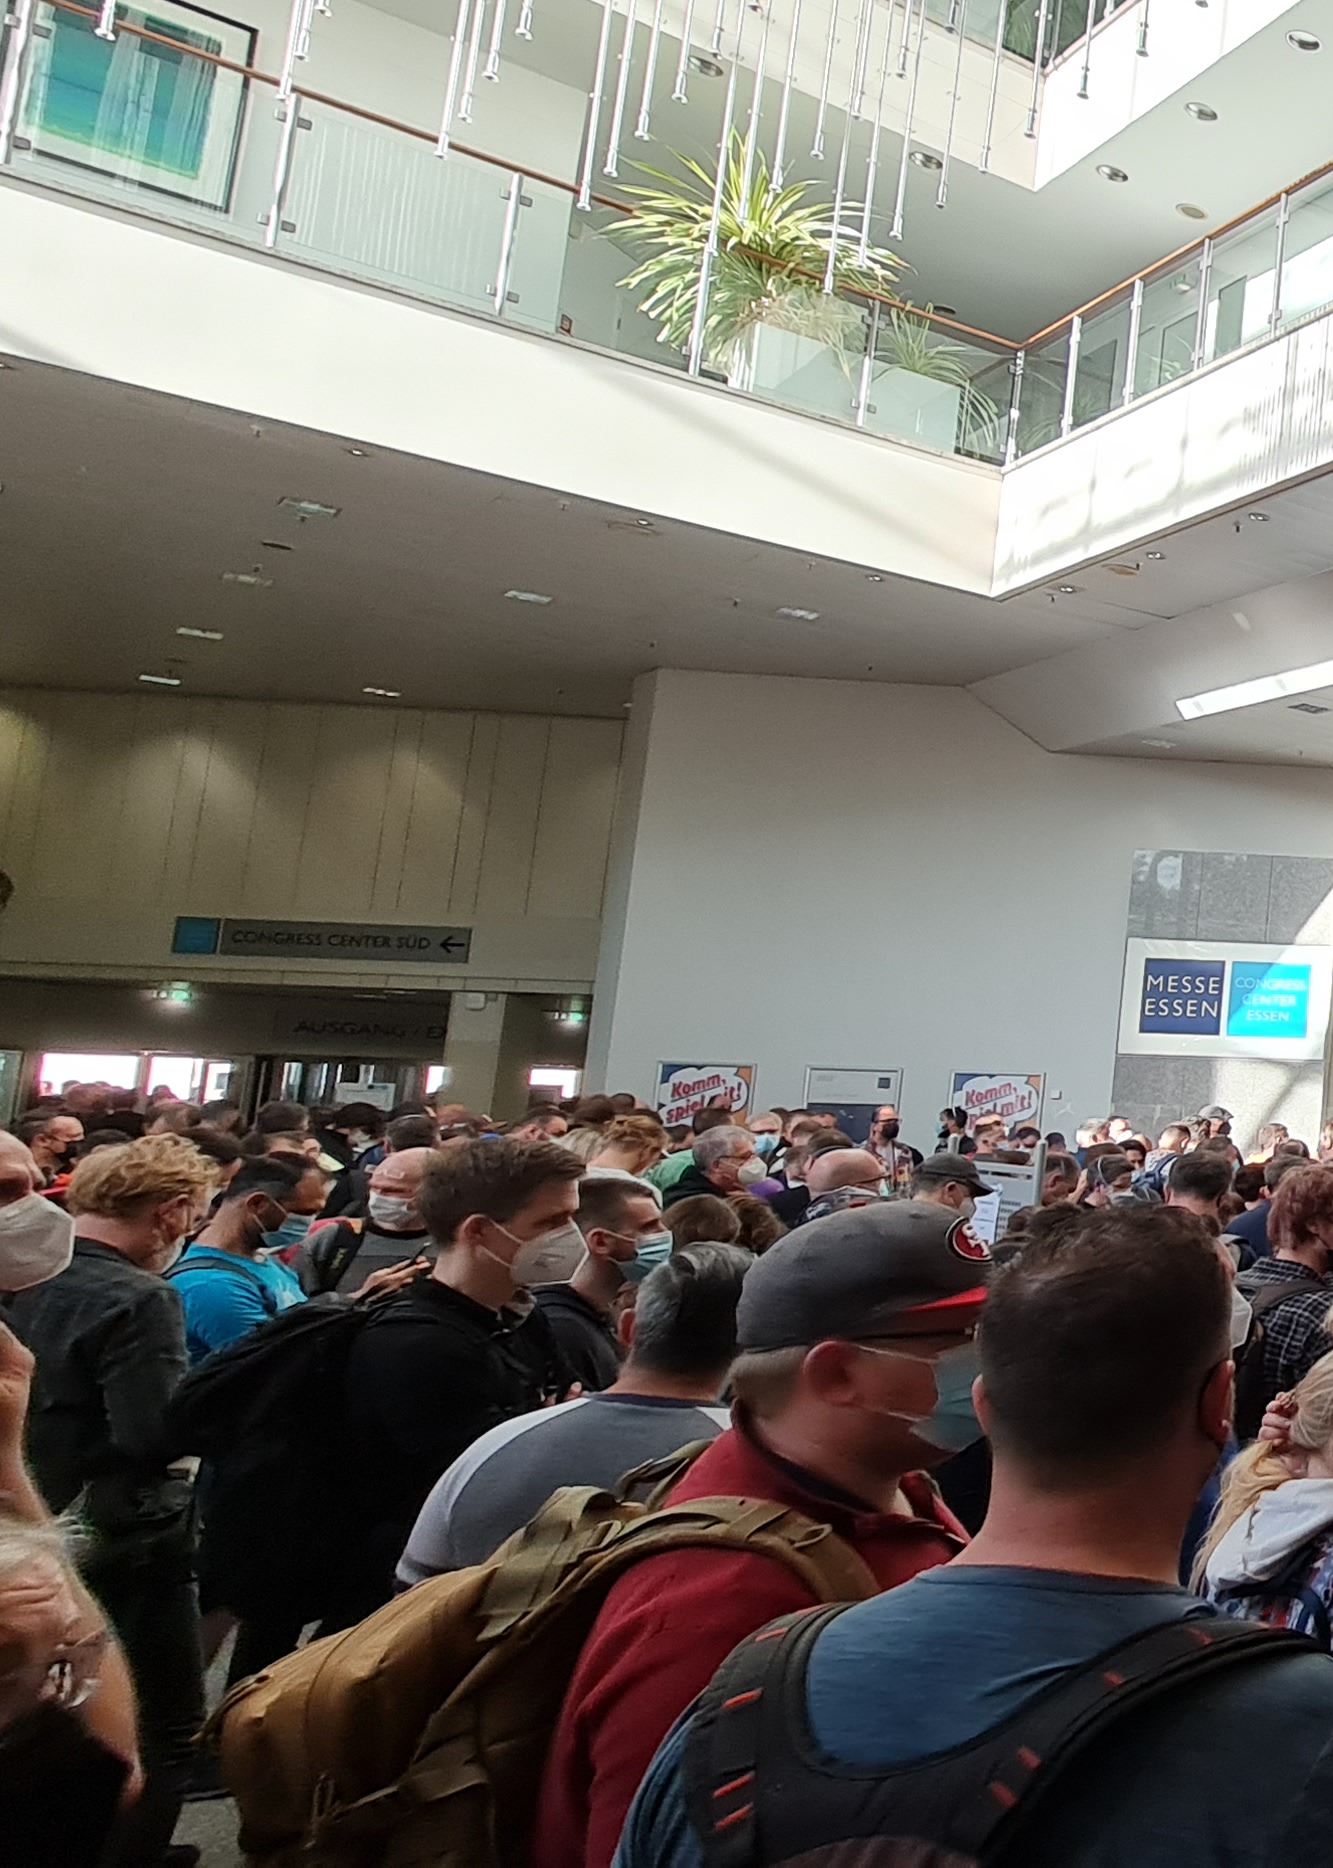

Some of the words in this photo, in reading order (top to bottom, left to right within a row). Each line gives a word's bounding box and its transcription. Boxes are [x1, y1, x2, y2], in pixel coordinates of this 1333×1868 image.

[231, 930, 321, 947] CONGRESS
[327, 934, 391, 949] CENTER
[396, 935, 431, 950] SÜD
[1146, 974, 1221, 994] MESSE
[1234, 976, 1307, 991] CONGRESS
[1144, 998, 1219, 1018] ESSEN
[1242, 993, 1297, 1007] CENTER
[1246, 1009, 1290, 1022] ESSEN
[670, 1074, 726, 1098] Komm,
[965, 1082, 1018, 1106] Komm,
